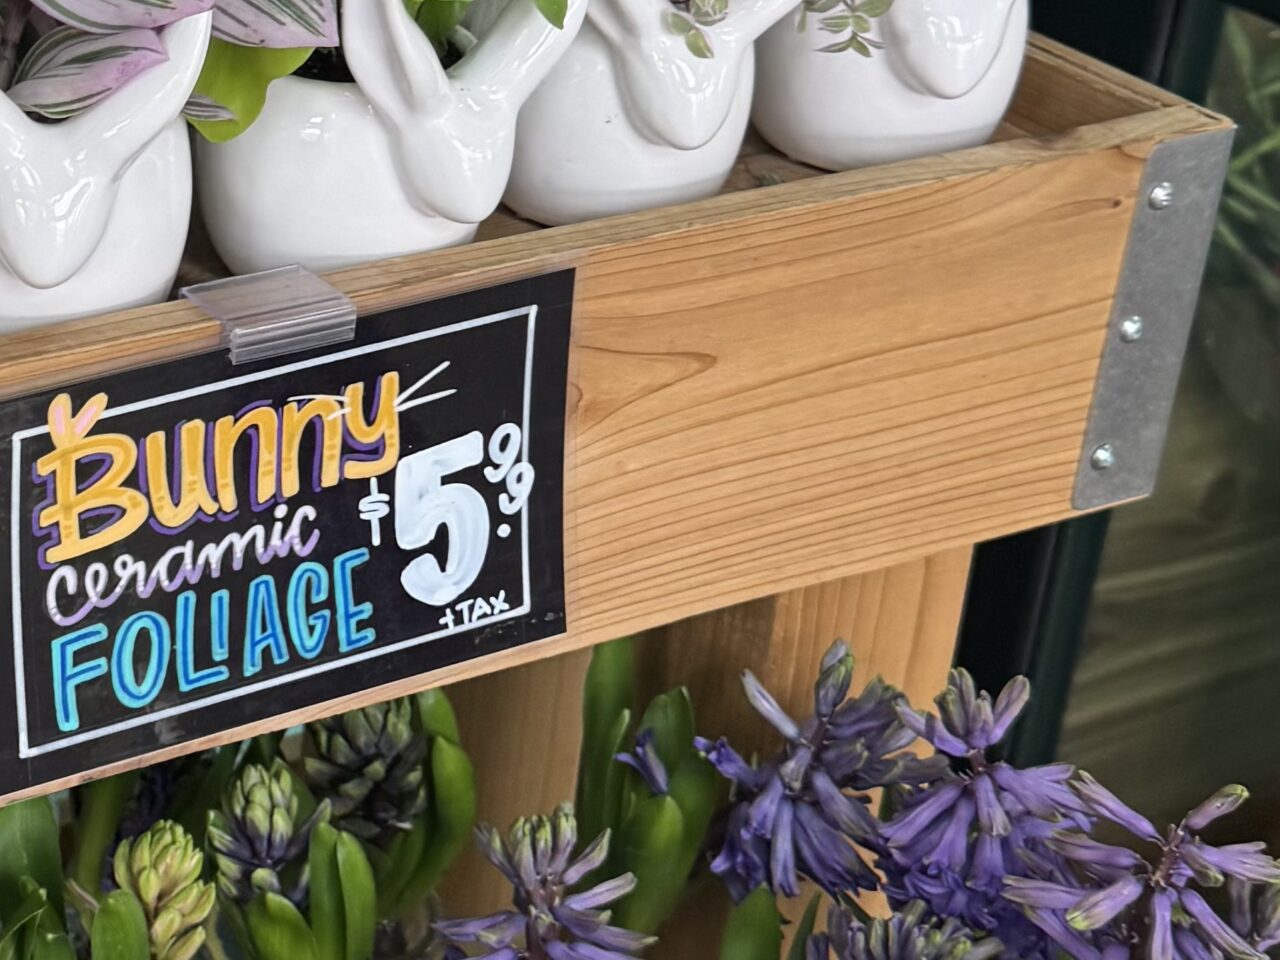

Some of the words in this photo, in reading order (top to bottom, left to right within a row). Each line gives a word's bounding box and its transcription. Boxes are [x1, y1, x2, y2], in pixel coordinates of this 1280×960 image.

[33, 371, 401, 570] Bunny
[45, 504, 321, 627] ceramic
[51, 548, 377, 732] FOLIAGE
